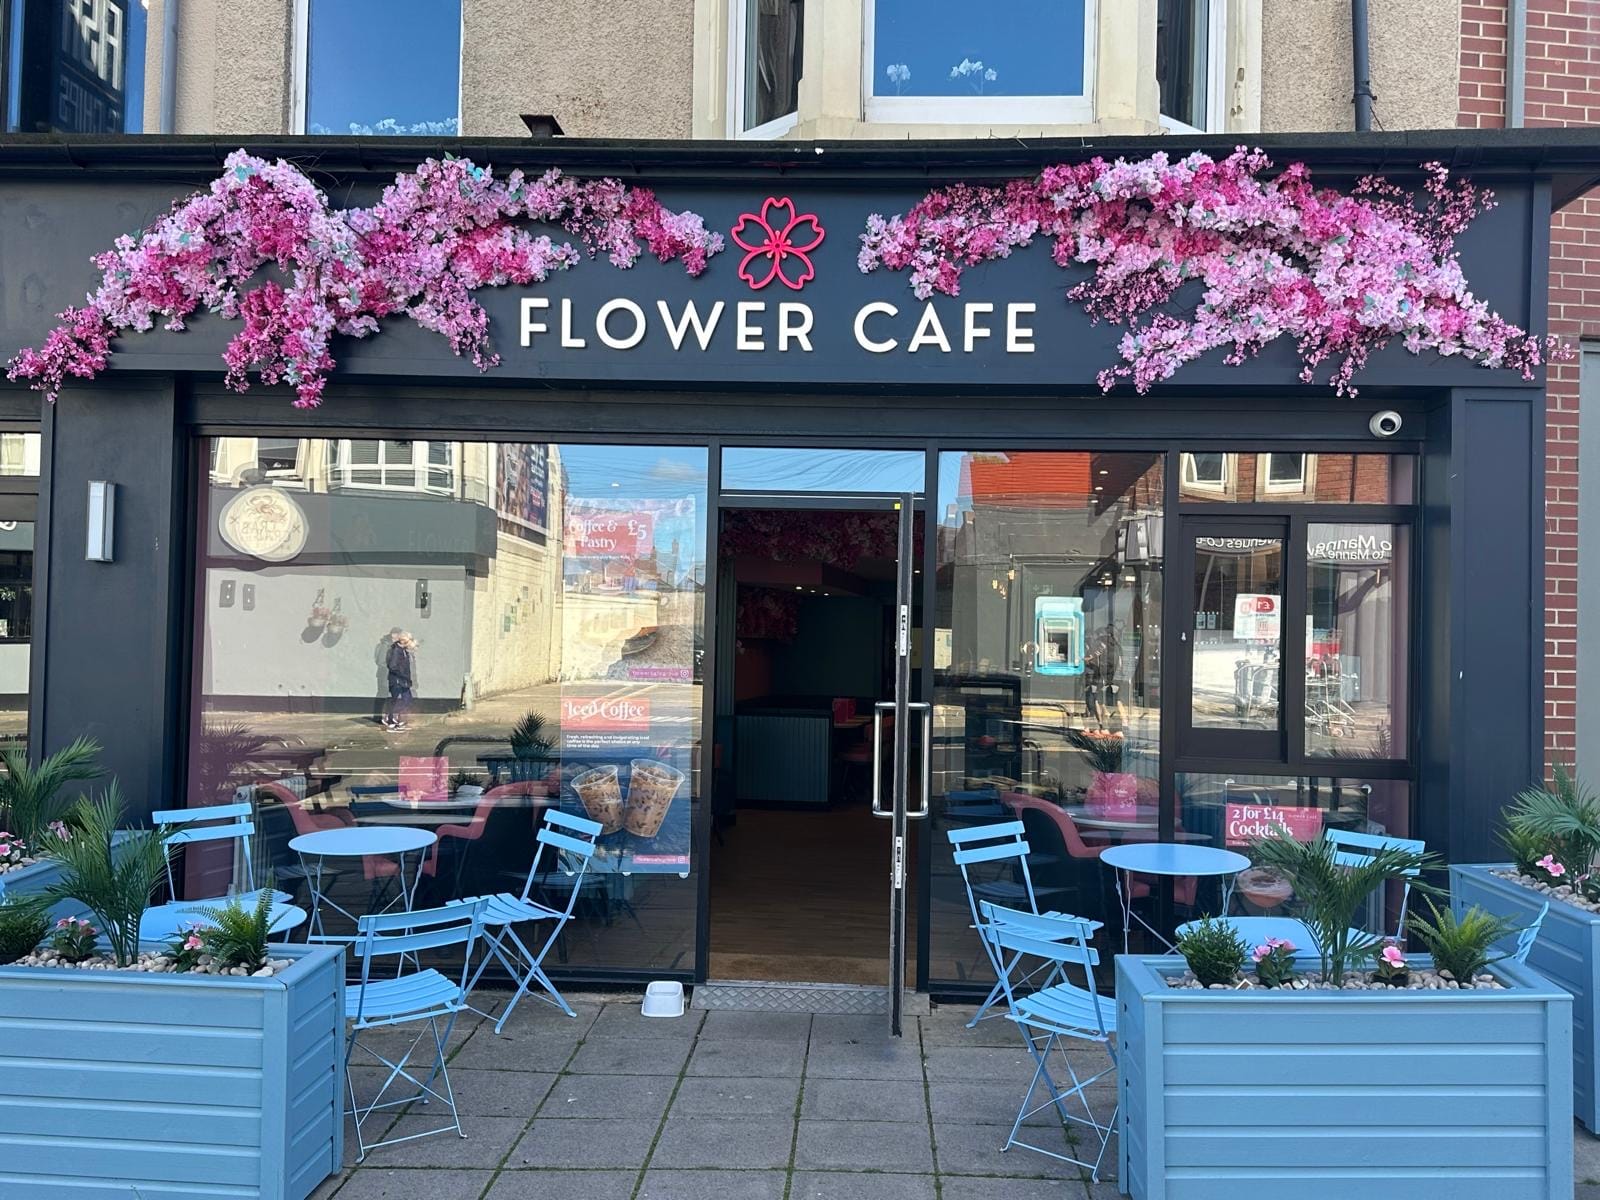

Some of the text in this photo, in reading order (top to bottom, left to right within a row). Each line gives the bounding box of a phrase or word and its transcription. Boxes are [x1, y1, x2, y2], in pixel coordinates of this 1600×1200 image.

[519, 297, 1037, 353] FLOWER CAFE
[627, 520, 648, 540] £5
[600, 700, 644, 720] Coffee
[1232, 806, 1285, 823] 2 for £14
